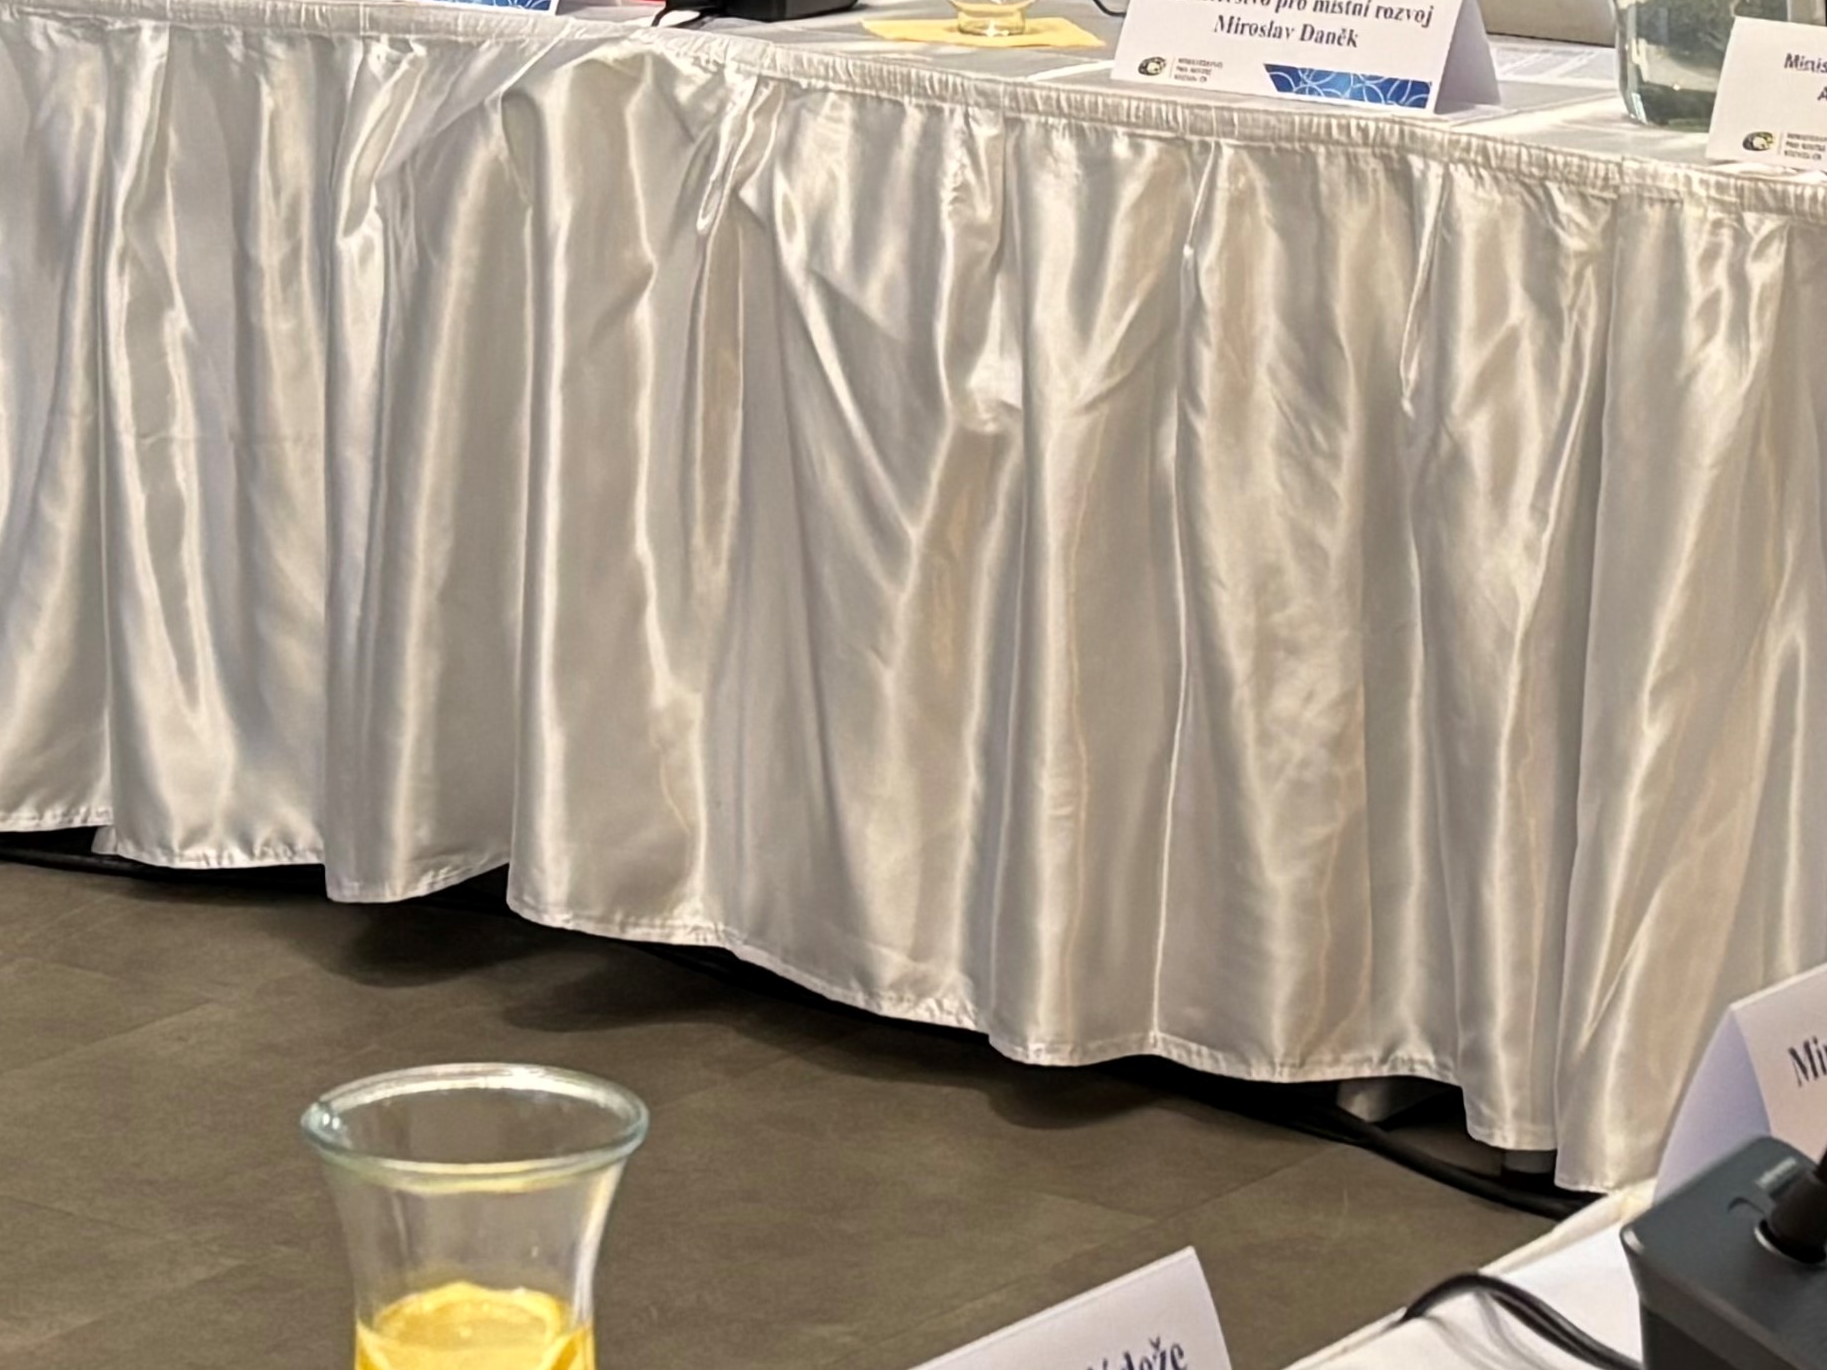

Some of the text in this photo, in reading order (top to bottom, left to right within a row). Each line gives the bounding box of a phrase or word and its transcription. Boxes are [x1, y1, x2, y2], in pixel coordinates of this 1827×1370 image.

[1213, 14, 1359, 49] Miroslav Daněk
[1375, 5, 1434, 29] rozvoj
